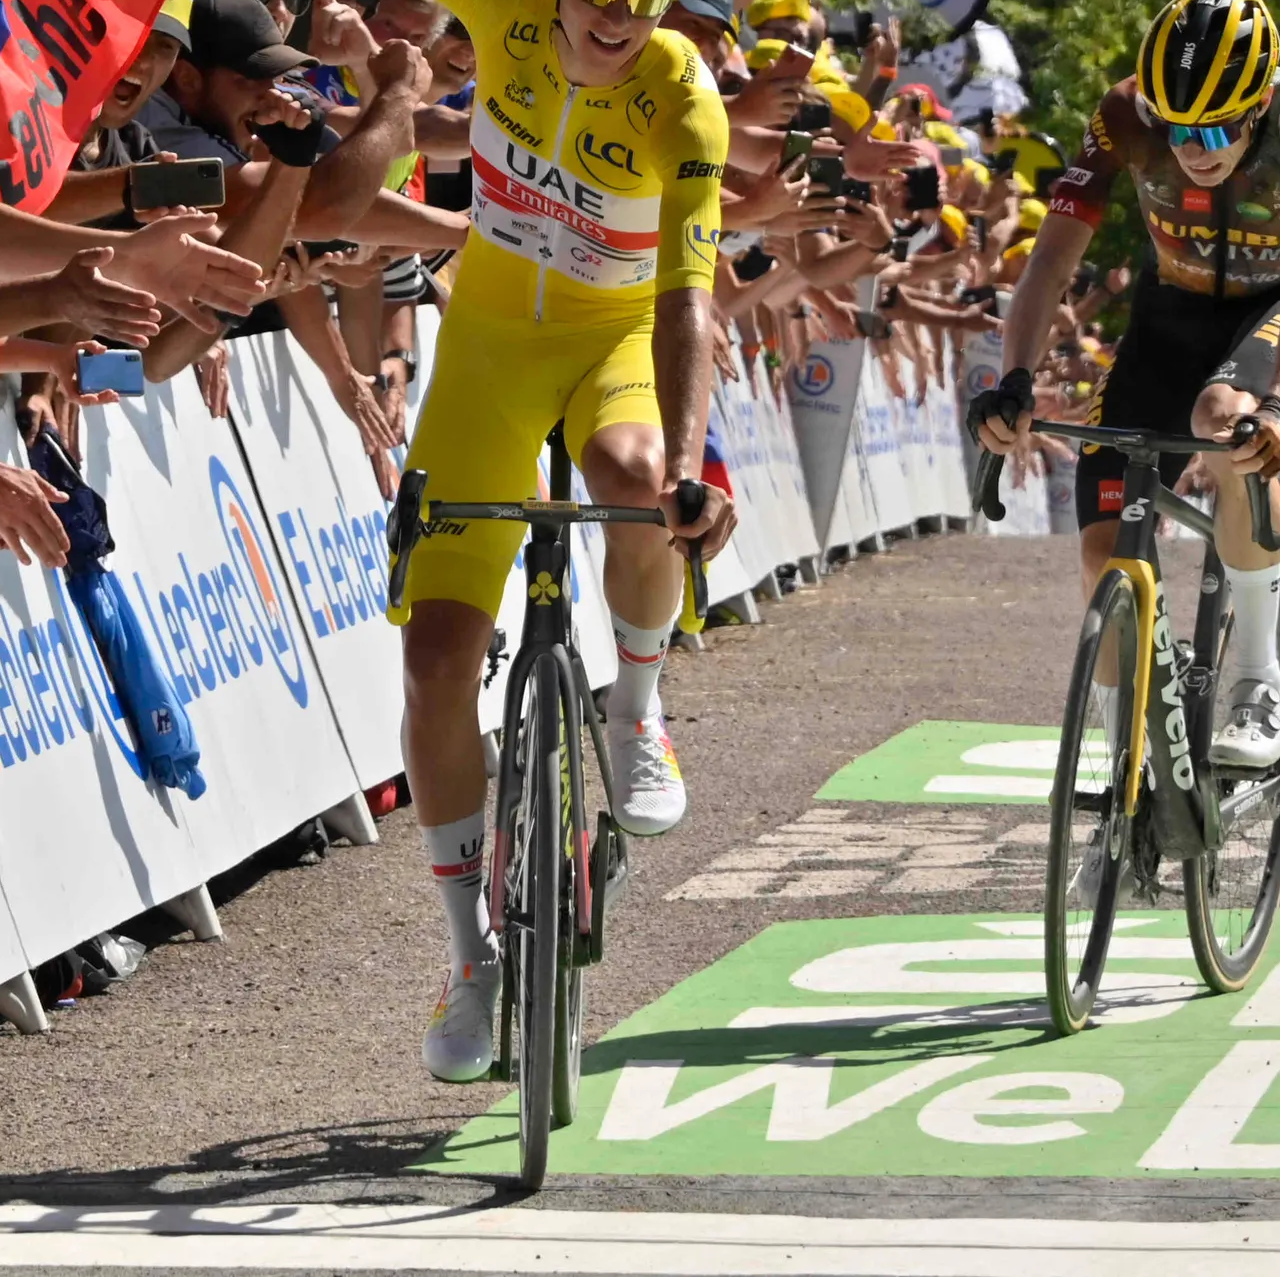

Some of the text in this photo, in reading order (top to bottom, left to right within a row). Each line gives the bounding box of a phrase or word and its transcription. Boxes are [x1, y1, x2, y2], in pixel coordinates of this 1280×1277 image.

[509, 20, 540, 44] LCL
[1180, 41, 1197, 70] JONAS
[586, 98, 613, 110] LCL
[583, 132, 643, 178] LCL
[505, 141, 605, 220] UAE
[505, 179, 607, 242] Emirates
[420, 521, 469, 537] tini
[597, 1055, 1125, 1146] We
